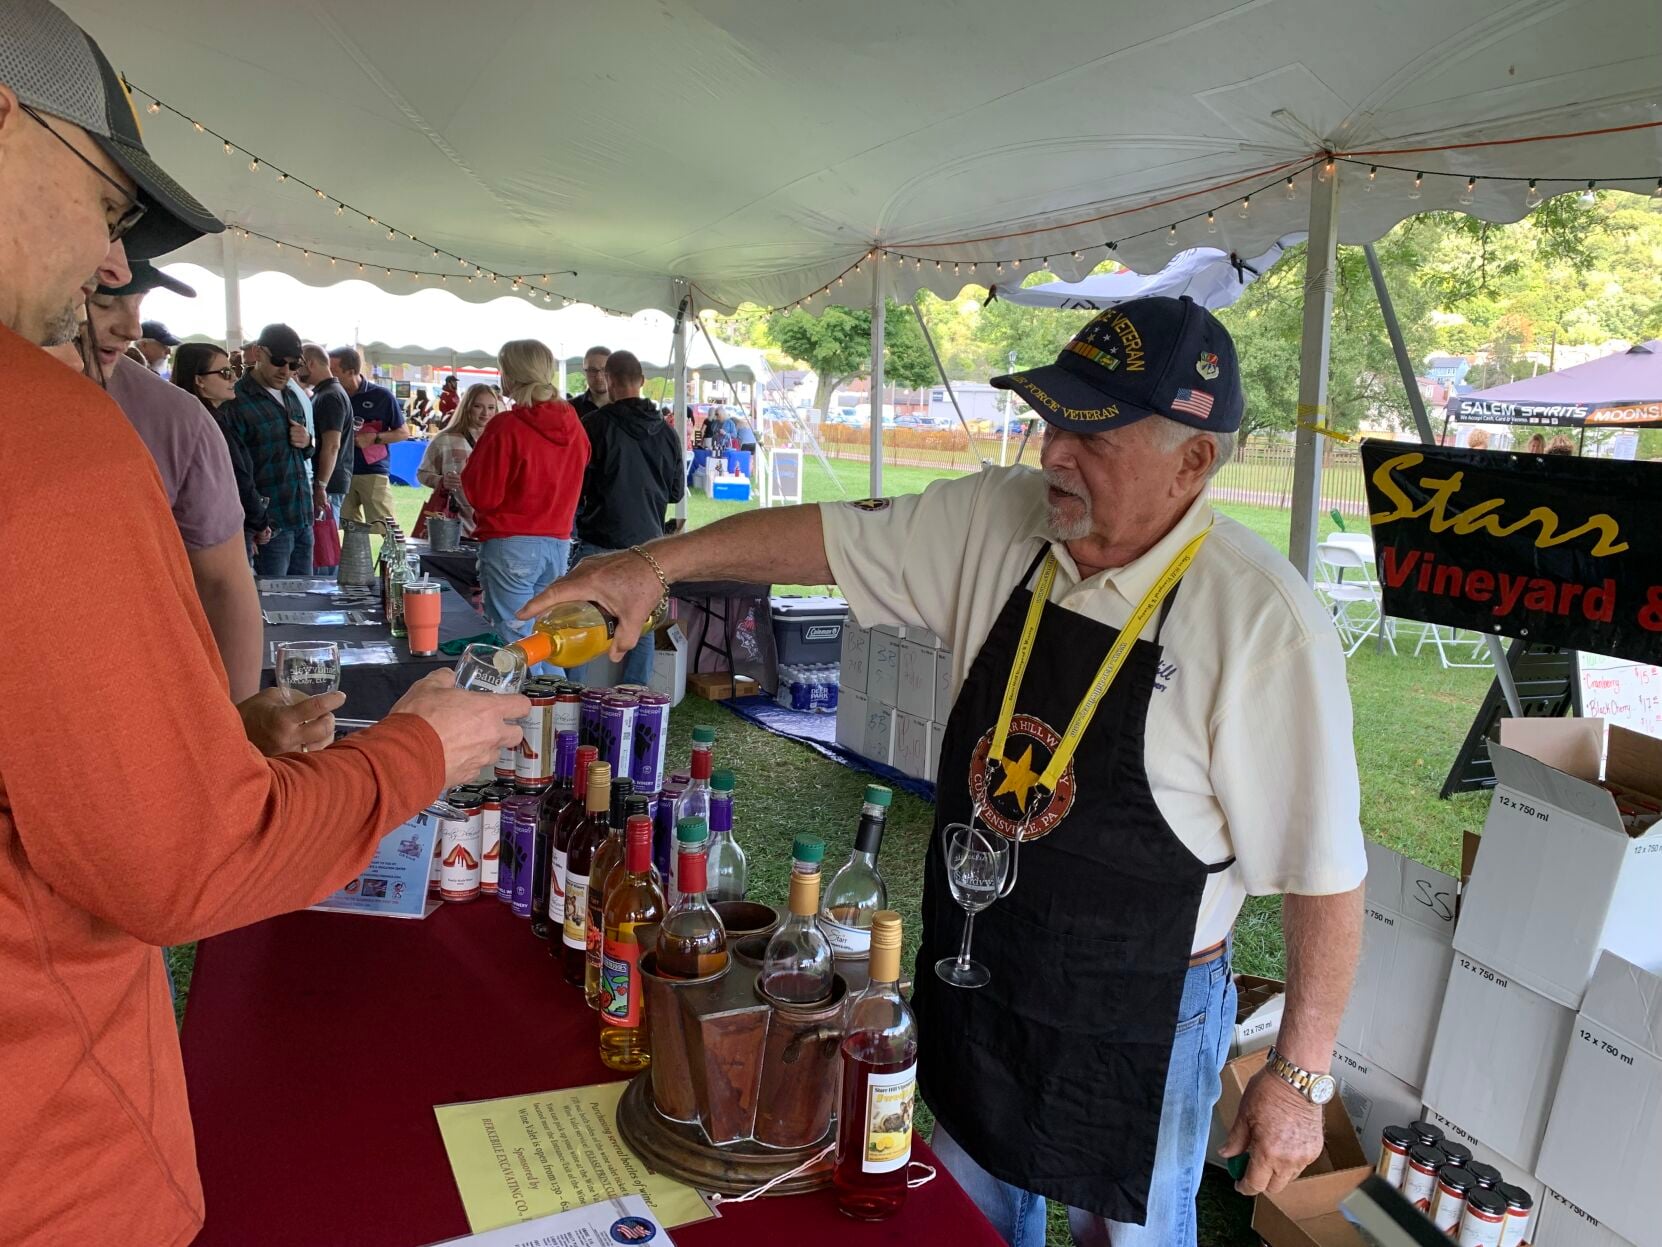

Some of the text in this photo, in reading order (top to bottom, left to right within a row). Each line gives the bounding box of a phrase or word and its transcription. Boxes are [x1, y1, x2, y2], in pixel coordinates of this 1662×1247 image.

[1112, 313, 1145, 371] VETERAN
[1024, 383, 1060, 412] FORCE
[1062, 404, 1120, 421] VETERAN
[1461, 401, 1588, 419] SALEM SPIRITS
[1371, 452, 1629, 557] Starr
[1382, 545, 1662, 632] Vineyard &
[811, 628, 833, 636] Coleman
[1020, 720, 1044, 737] HILL
[1041, 811, 1059, 826] PA
[1500, 796, 1510, 806] 12
[1519, 803, 1535, 816] 750
[1536, 812, 1549, 822] ml
[1413, 880, 1453, 921] SS
[1370, 910, 1383, 921] 750
[1384, 918, 1394, 926] ml
[1460, 959, 1470, 969] 12
[1479, 968, 1494, 981] 750
[1495, 978, 1508, 988] ml
[1255, 1023, 1265, 1032] 750
[1265, 1020, 1272, 1028] ml
[1580, 1030, 1634, 1065] 12 x 750 ml
[1344, 1055, 1357, 1068] 750
[1357, 1065, 1368, 1074] ml
[518, 1107, 530, 1126] Wine
[525, 1124, 539, 1141] Valet
[1434, 1112, 1444, 1122] 12
[1452, 1125, 1466, 1137] 750
[1467, 1134, 1479, 1146] ml
[482, 1118, 503, 1153] BERKEBILE
[497, 1153, 520, 1198] EXCAVATING
[535, 1147, 548, 1164] open
[589, 1102, 658, 1208] Purchasing several bottles of wine?
[513, 1147, 540, 1190] Sponsored by
[544, 1163, 557, 1181] from
[550, 1180, 562, 1196] 1:30
[575, 1189, 588, 1204] Wine
[1550, 1190, 1560, 1201] 12
[1569, 1203, 1585, 1217] 750
[1586, 1214, 1598, 1227] ml
